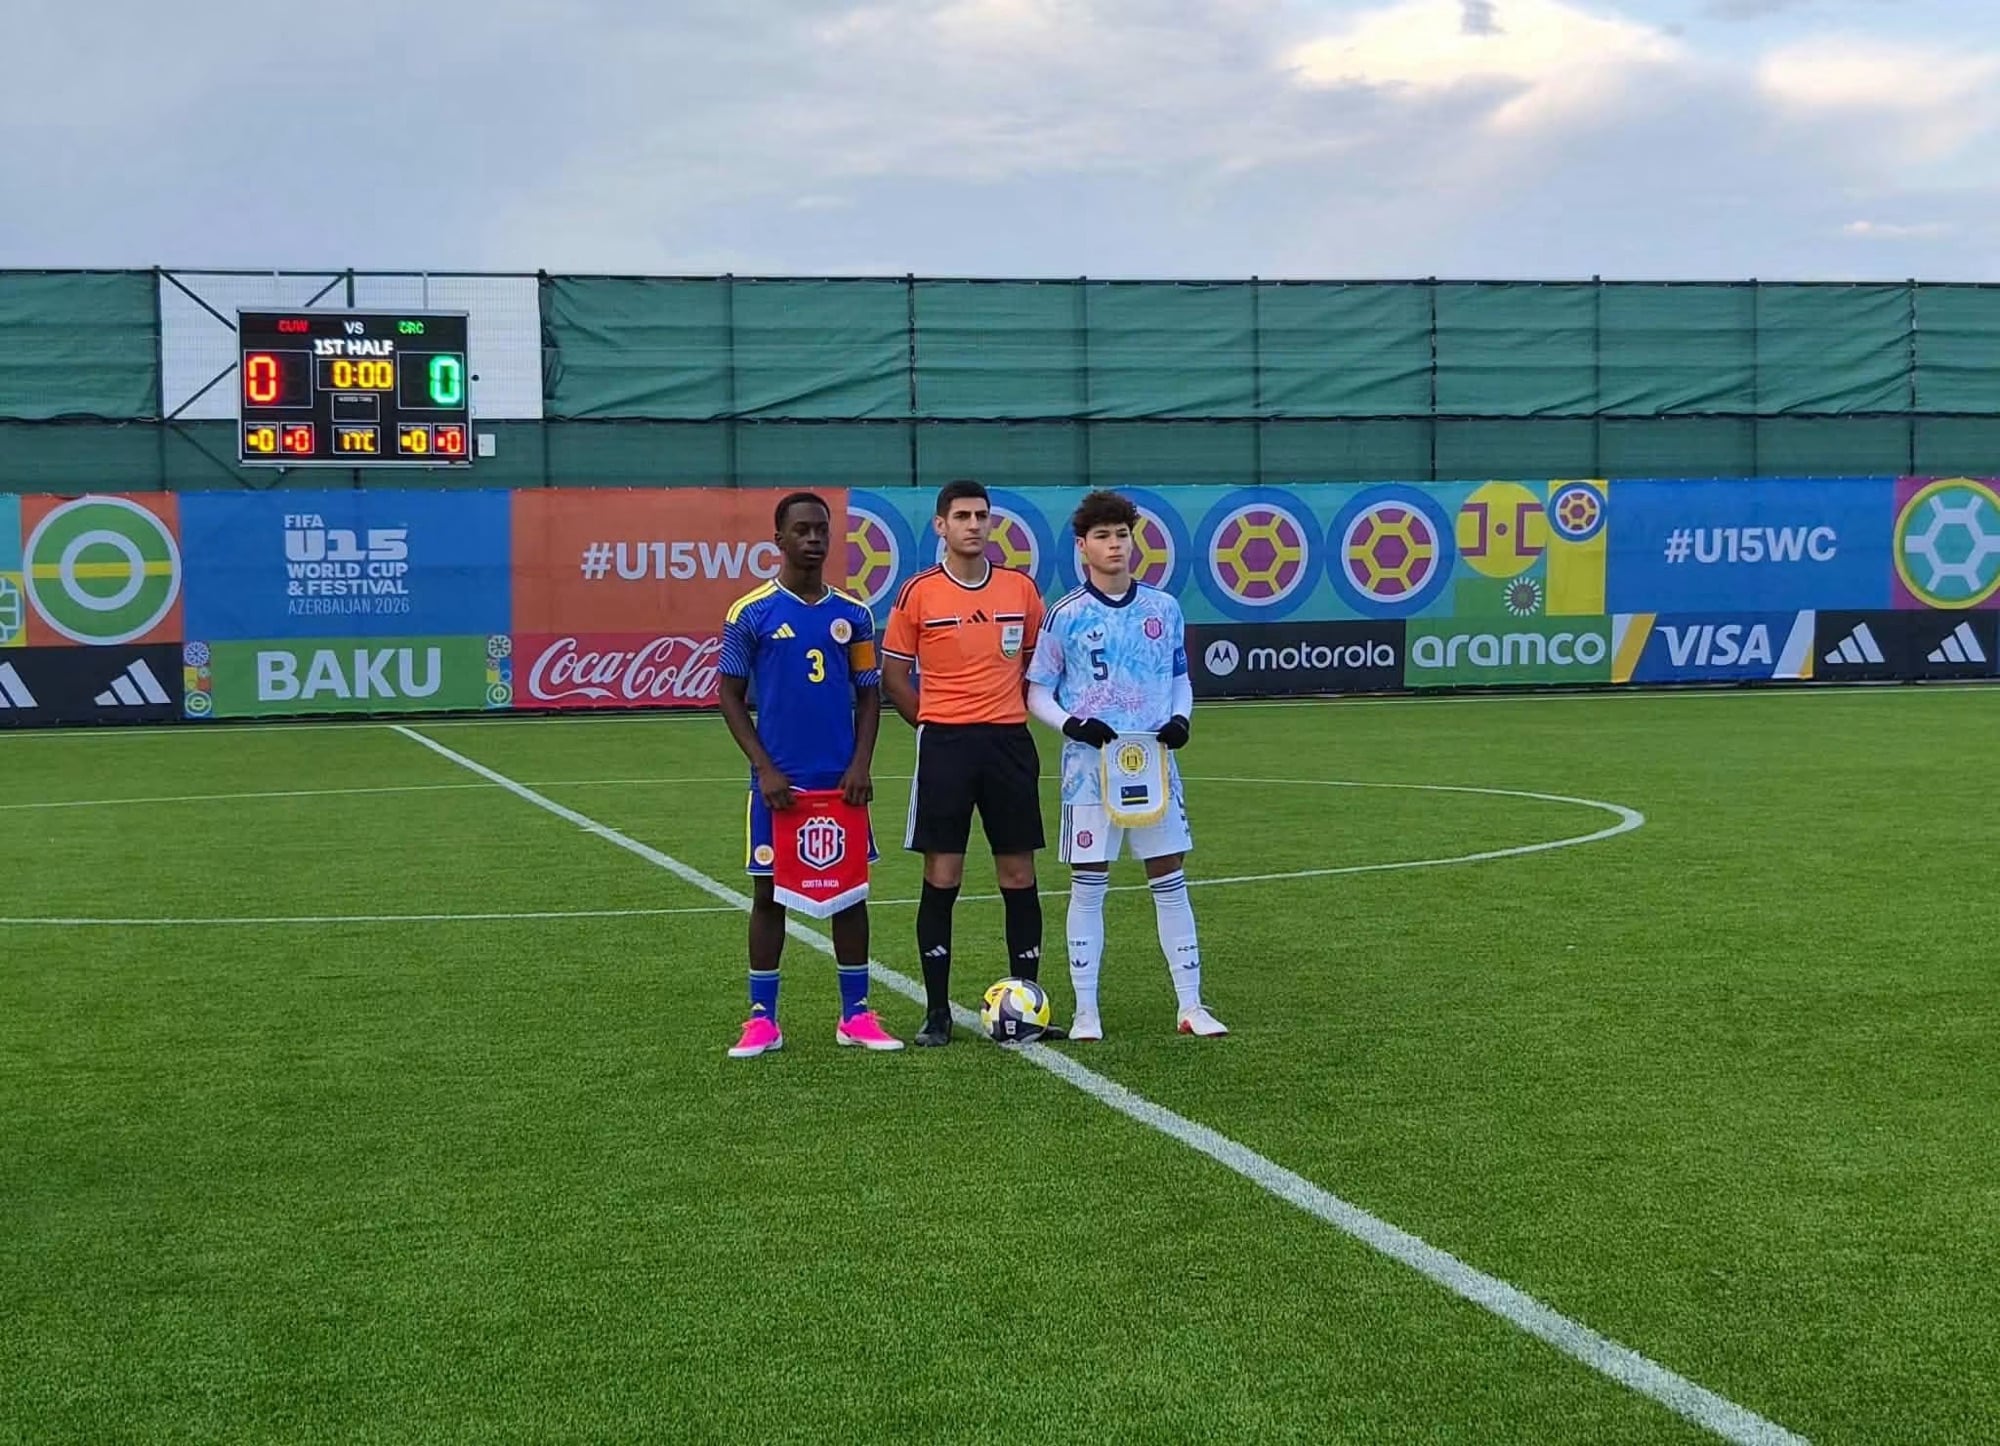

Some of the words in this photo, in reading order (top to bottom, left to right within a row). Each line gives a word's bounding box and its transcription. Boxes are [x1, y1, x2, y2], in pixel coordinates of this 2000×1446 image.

[278, 320, 309, 333] CUW
[343, 321, 365, 335] VS
[398, 320, 425, 335] CRC
[314, 339, 345, 355] 1ST
[347, 339, 394, 355] HALF
[248, 355, 278, 403] 0
[333, 361, 393, 388] 0:00
[429, 356, 461, 404] 0
[258, 428, 274, 452] 0
[294, 429, 309, 452] 0
[411, 429, 427, 453] 0
[446, 430, 460, 453] 0
[284, 514, 325, 528] FIFA
[285, 528, 409, 561] U15
[1663, 526, 1838, 563] #U15WC
[286, 562, 361, 579] WORLD
[367, 561, 409, 578] CUP
[580, 541, 781, 580] #U15WC
[287, 580, 305, 596] &
[307, 579, 409, 596] FESTIVAL
[288, 598, 371, 615] AZERBAIJAN
[375, 597, 410, 614] 2026
[1247, 639, 1395, 671] motorola
[1412, 632, 1607, 667] aramco
[1656, 623, 1773, 666] VISA
[257, 647, 442, 701] BAKU
[805, 649, 826, 683] 3
[1090, 648, 1109, 681] 5
[807, 828, 834, 860] CR
